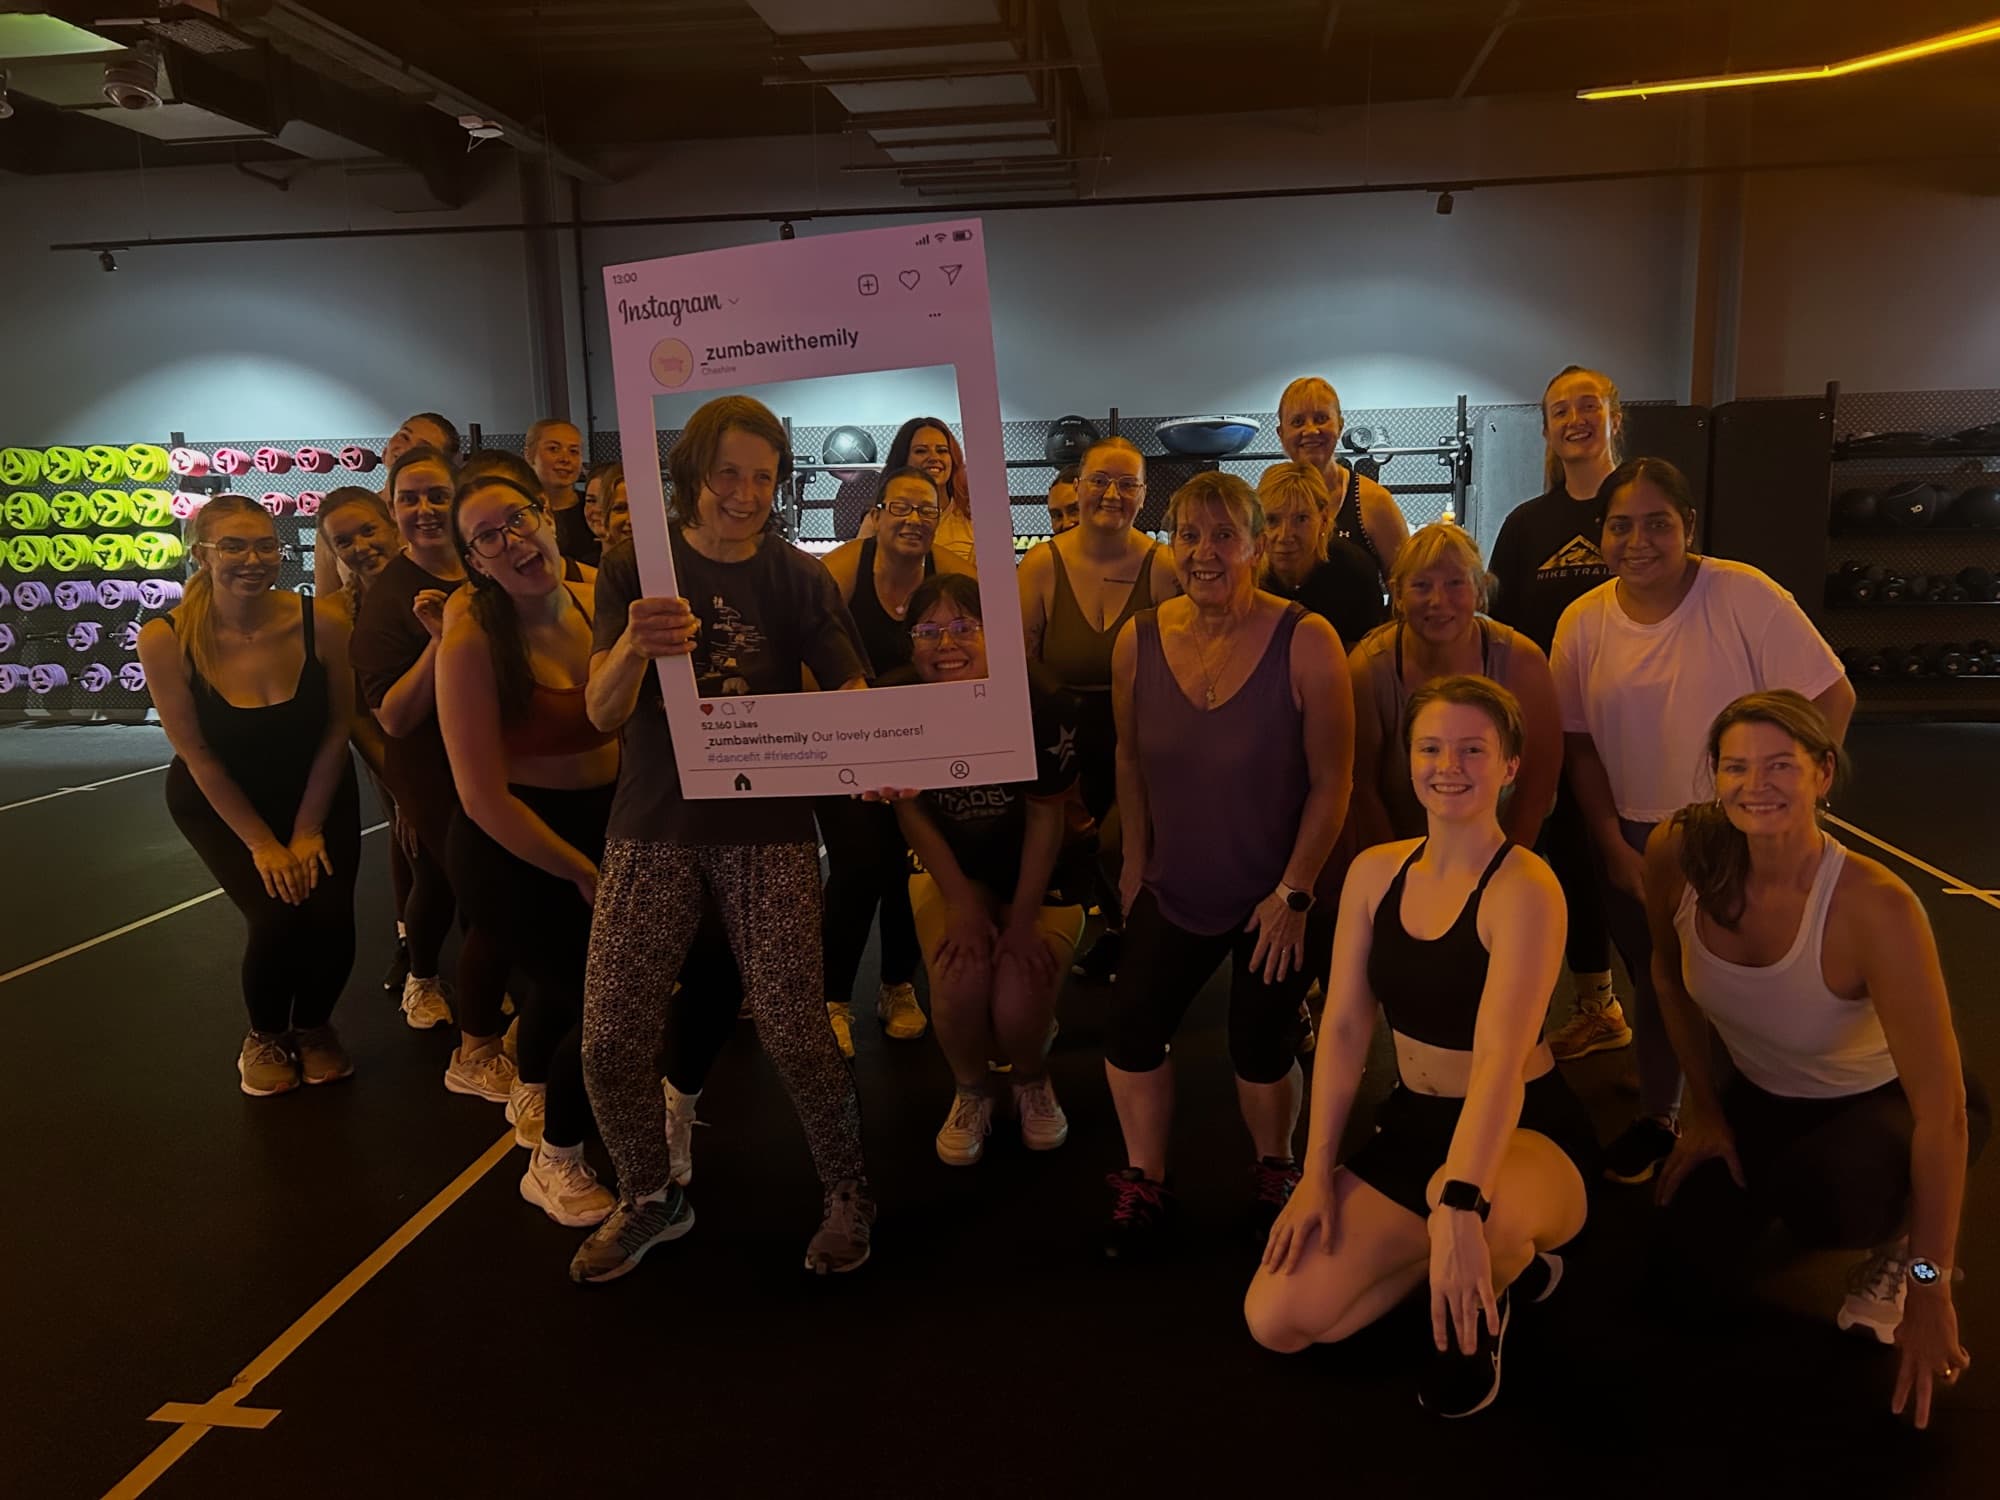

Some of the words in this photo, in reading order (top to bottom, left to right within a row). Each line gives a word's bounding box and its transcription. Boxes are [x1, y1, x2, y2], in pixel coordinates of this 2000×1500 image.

[612, 272, 638, 284] 13:00
[618, 293, 722, 327] Instagram
[700, 328, 859, 366] _zumbawithemily
[1536, 569, 1569, 581] NIKE
[734, 719, 758, 729] Likes
[704, 731, 808, 750] _zumbawithemily
[812, 731, 833, 742] Our
[836, 729, 870, 741] lovely
[873, 724, 924, 739] dancers!
[708, 751, 760, 763] #dancefit
[764, 750, 828, 761] #friendship
[932, 786, 1016, 813] ITADEL
